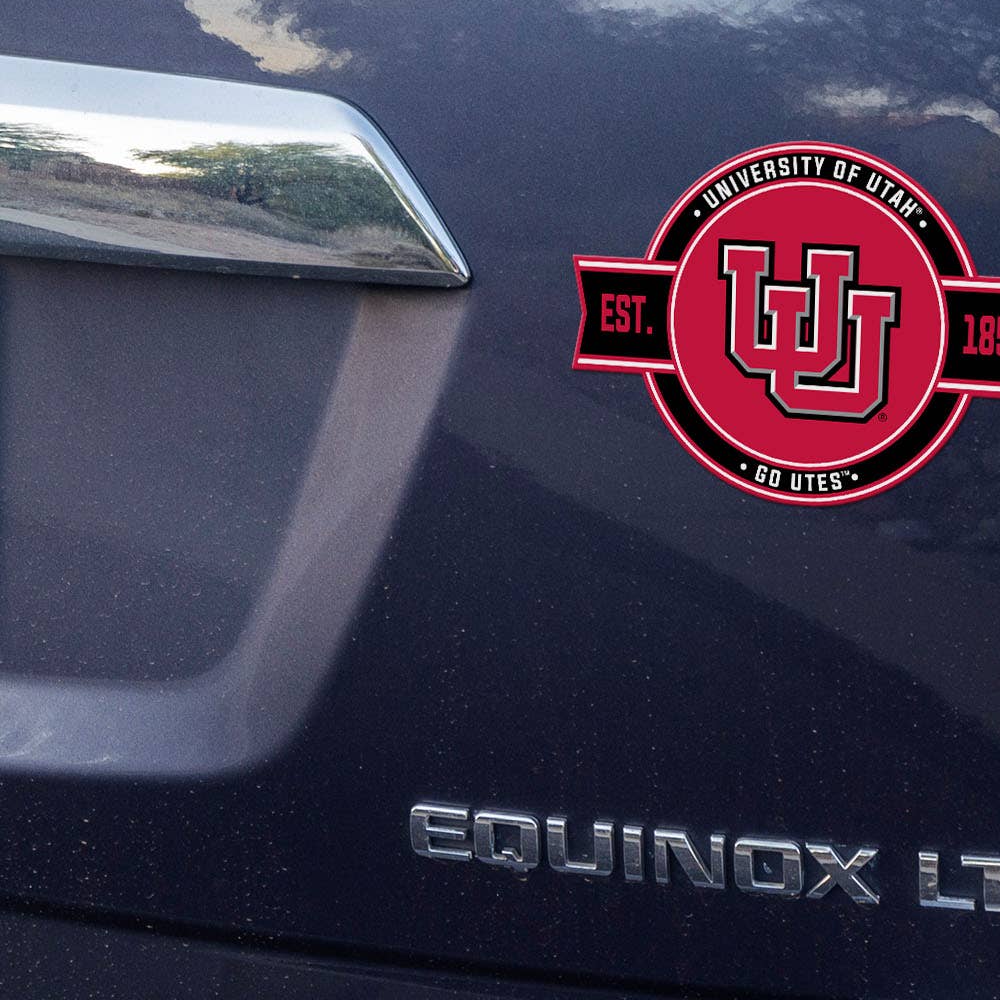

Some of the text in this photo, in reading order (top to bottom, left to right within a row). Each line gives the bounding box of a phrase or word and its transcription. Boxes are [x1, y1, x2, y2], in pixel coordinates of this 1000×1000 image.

[702, 156, 826, 209] UNIVERSITY
[833, 160, 862, 183] OF
[601, 293, 653, 335] EST.
[754, 464, 781, 488] GO
[409, 803, 880, 905] EQUINOX
